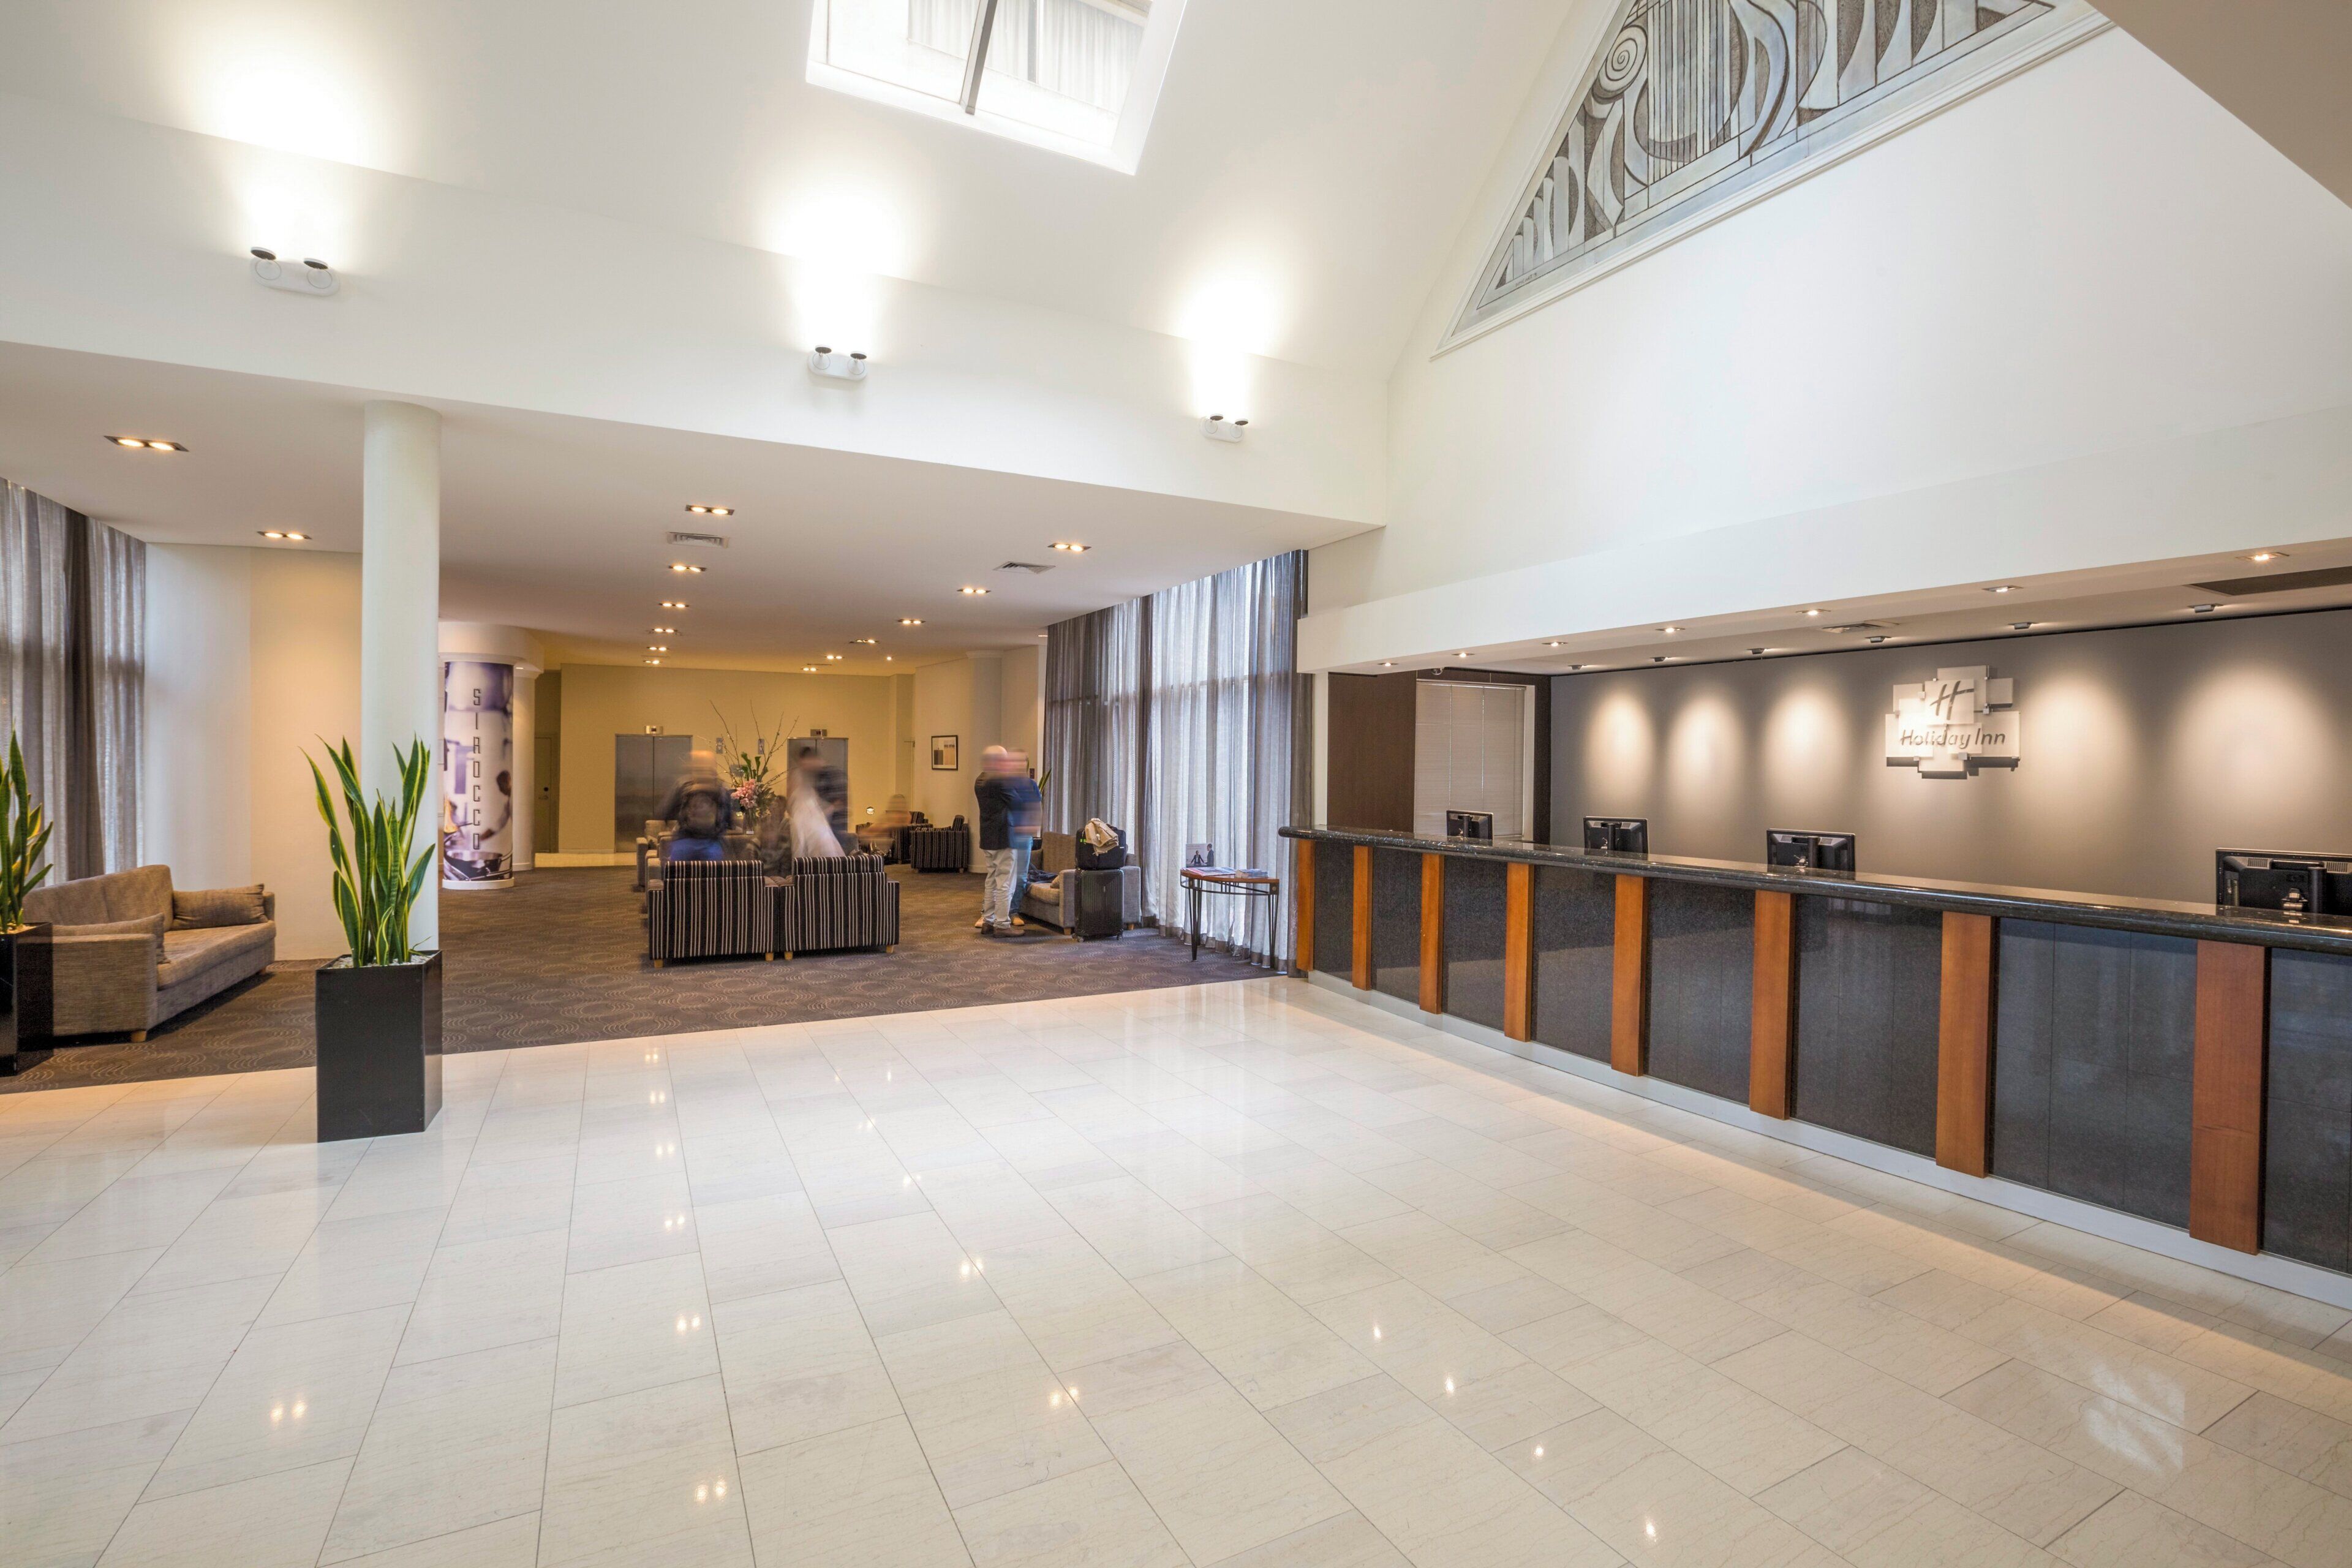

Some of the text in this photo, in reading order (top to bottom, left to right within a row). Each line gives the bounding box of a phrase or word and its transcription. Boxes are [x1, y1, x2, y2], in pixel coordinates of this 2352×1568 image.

[473, 688, 481, 850] SIROCCO
[1900, 727, 2006, 749] Holiday Inn
